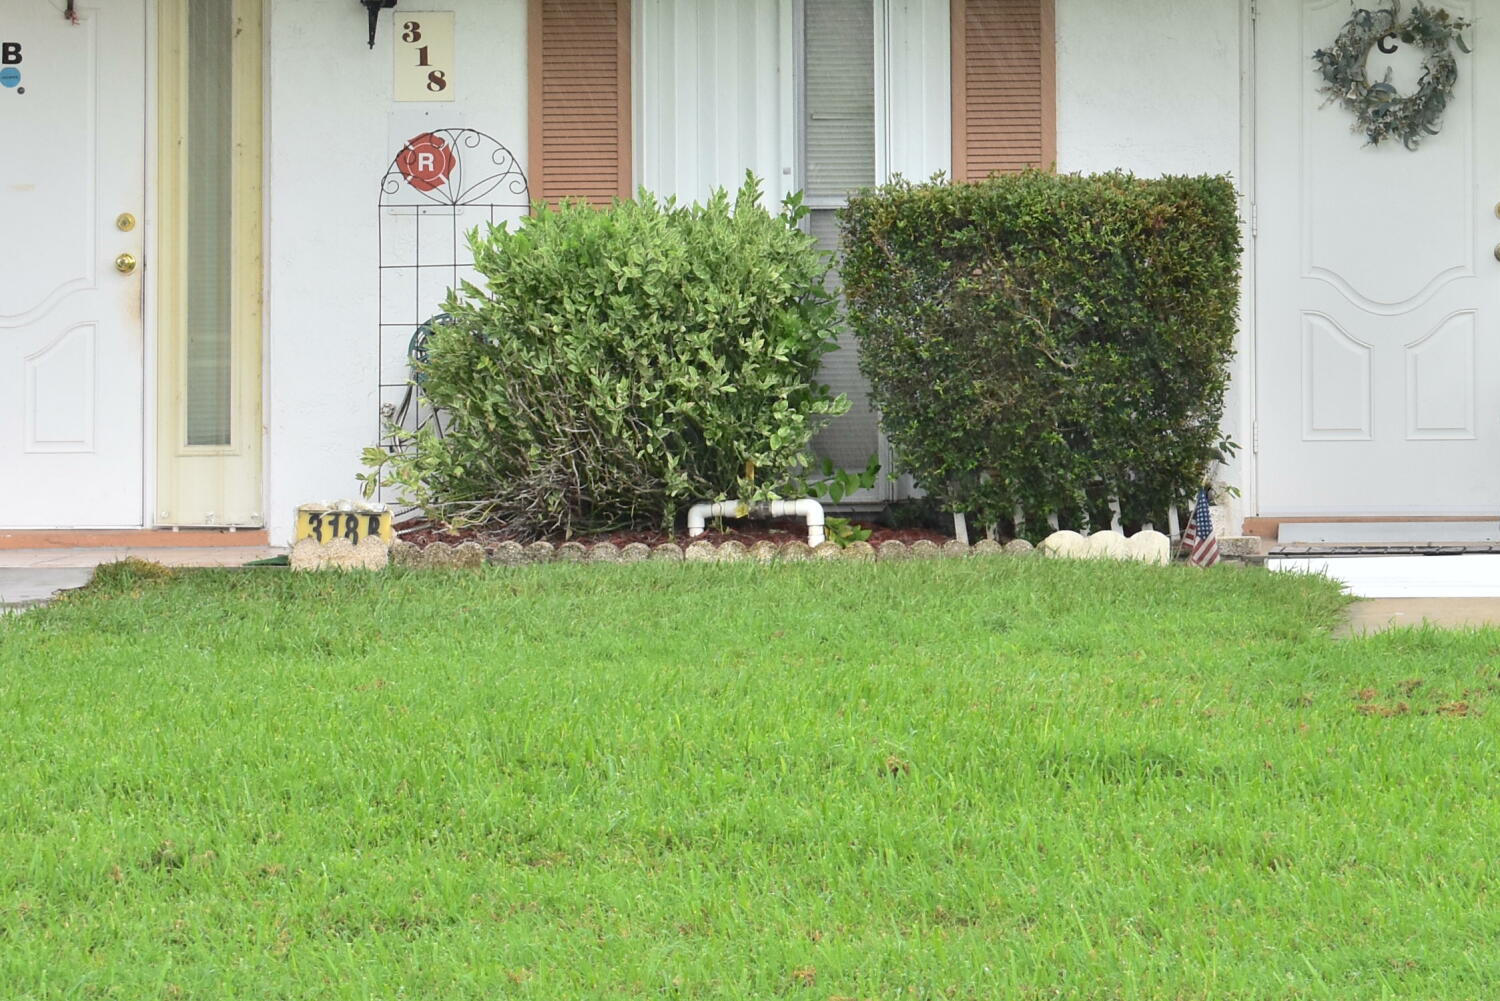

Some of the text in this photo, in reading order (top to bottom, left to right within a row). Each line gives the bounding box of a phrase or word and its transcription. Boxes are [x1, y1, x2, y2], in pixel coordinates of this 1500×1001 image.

[2, 42, 23, 64] B
[1377, 32, 1398, 54] C
[418, 153, 434, 171] R
